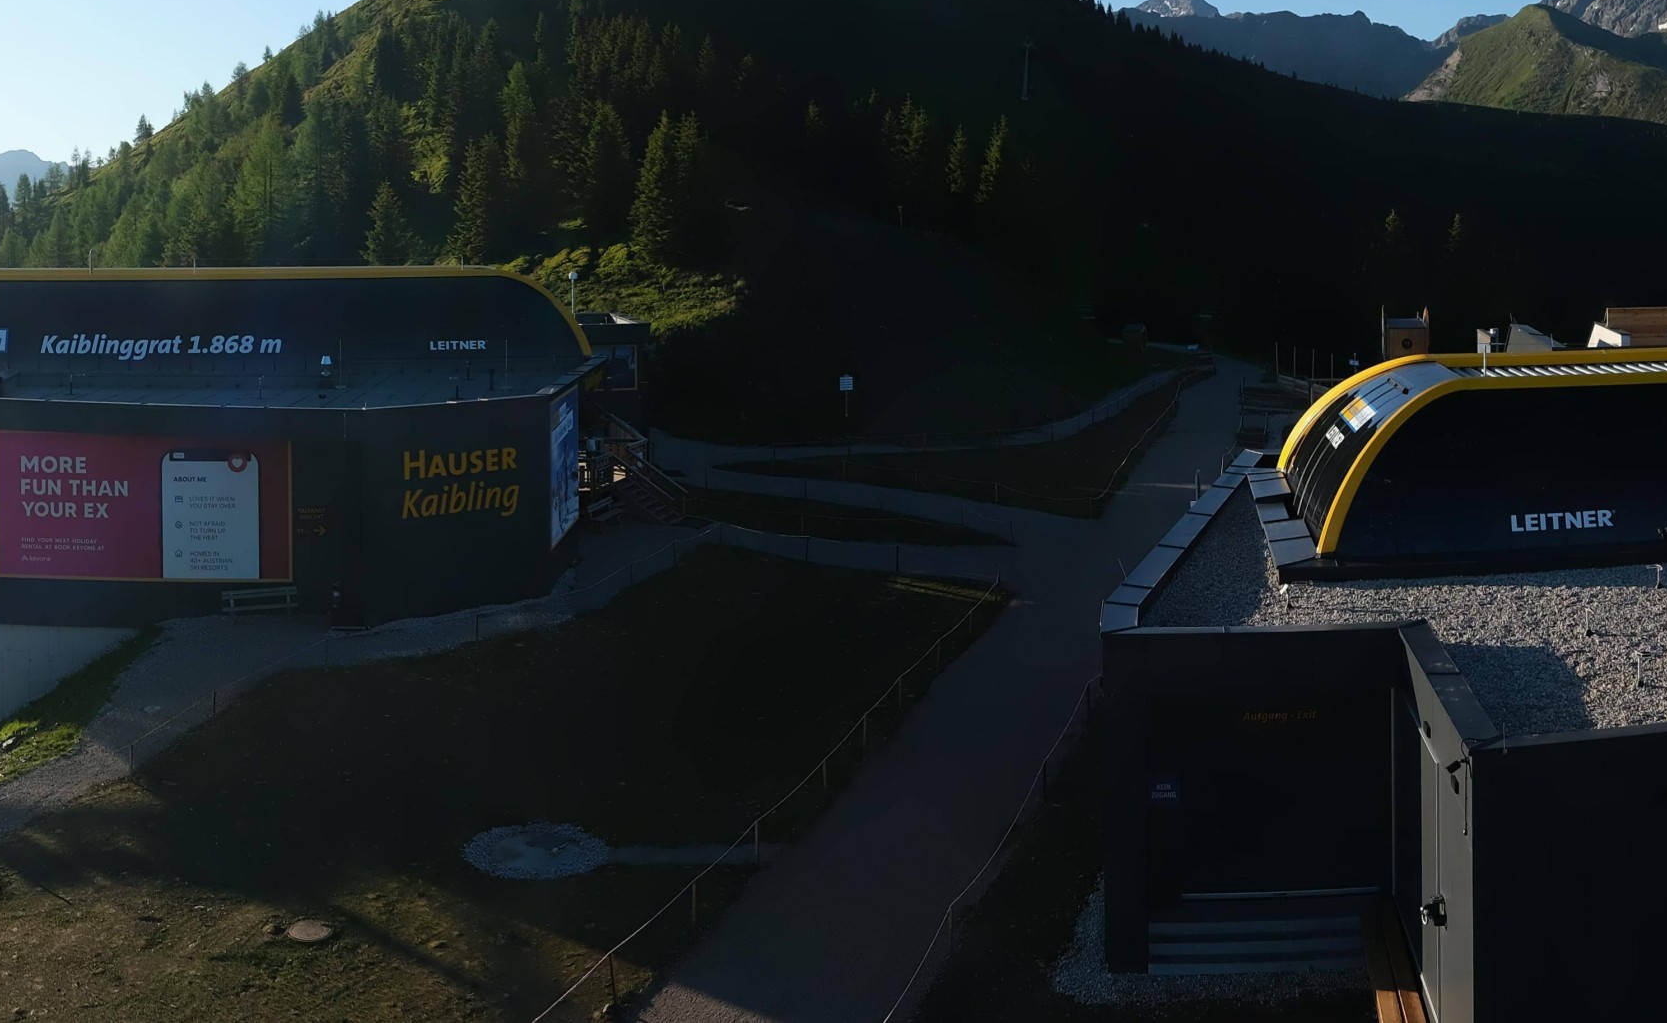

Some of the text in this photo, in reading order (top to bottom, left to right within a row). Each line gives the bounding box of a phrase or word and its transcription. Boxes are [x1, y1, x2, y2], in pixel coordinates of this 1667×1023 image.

[40, 334, 282, 360] Kaiblinggrat 1.868 m
[429, 340, 487, 351] LEITNER
[20, 456, 87, 474] MORE
[403, 447, 518, 480] HAUSER
[20, 479, 129, 497] FUN THAN
[402, 481, 520, 519] Kaibling
[22, 501, 109, 519] YOUR EX
[1510, 509, 1614, 532] LEITNER
[30, 555, 51, 563] keyone
[1243, 711, 1288, 723] Ausgang
[1297, 710, 1316, 719] Exit
[1151, 791, 1177, 799] ZUGANG
[1156, 783, 1171, 791] KEIN
